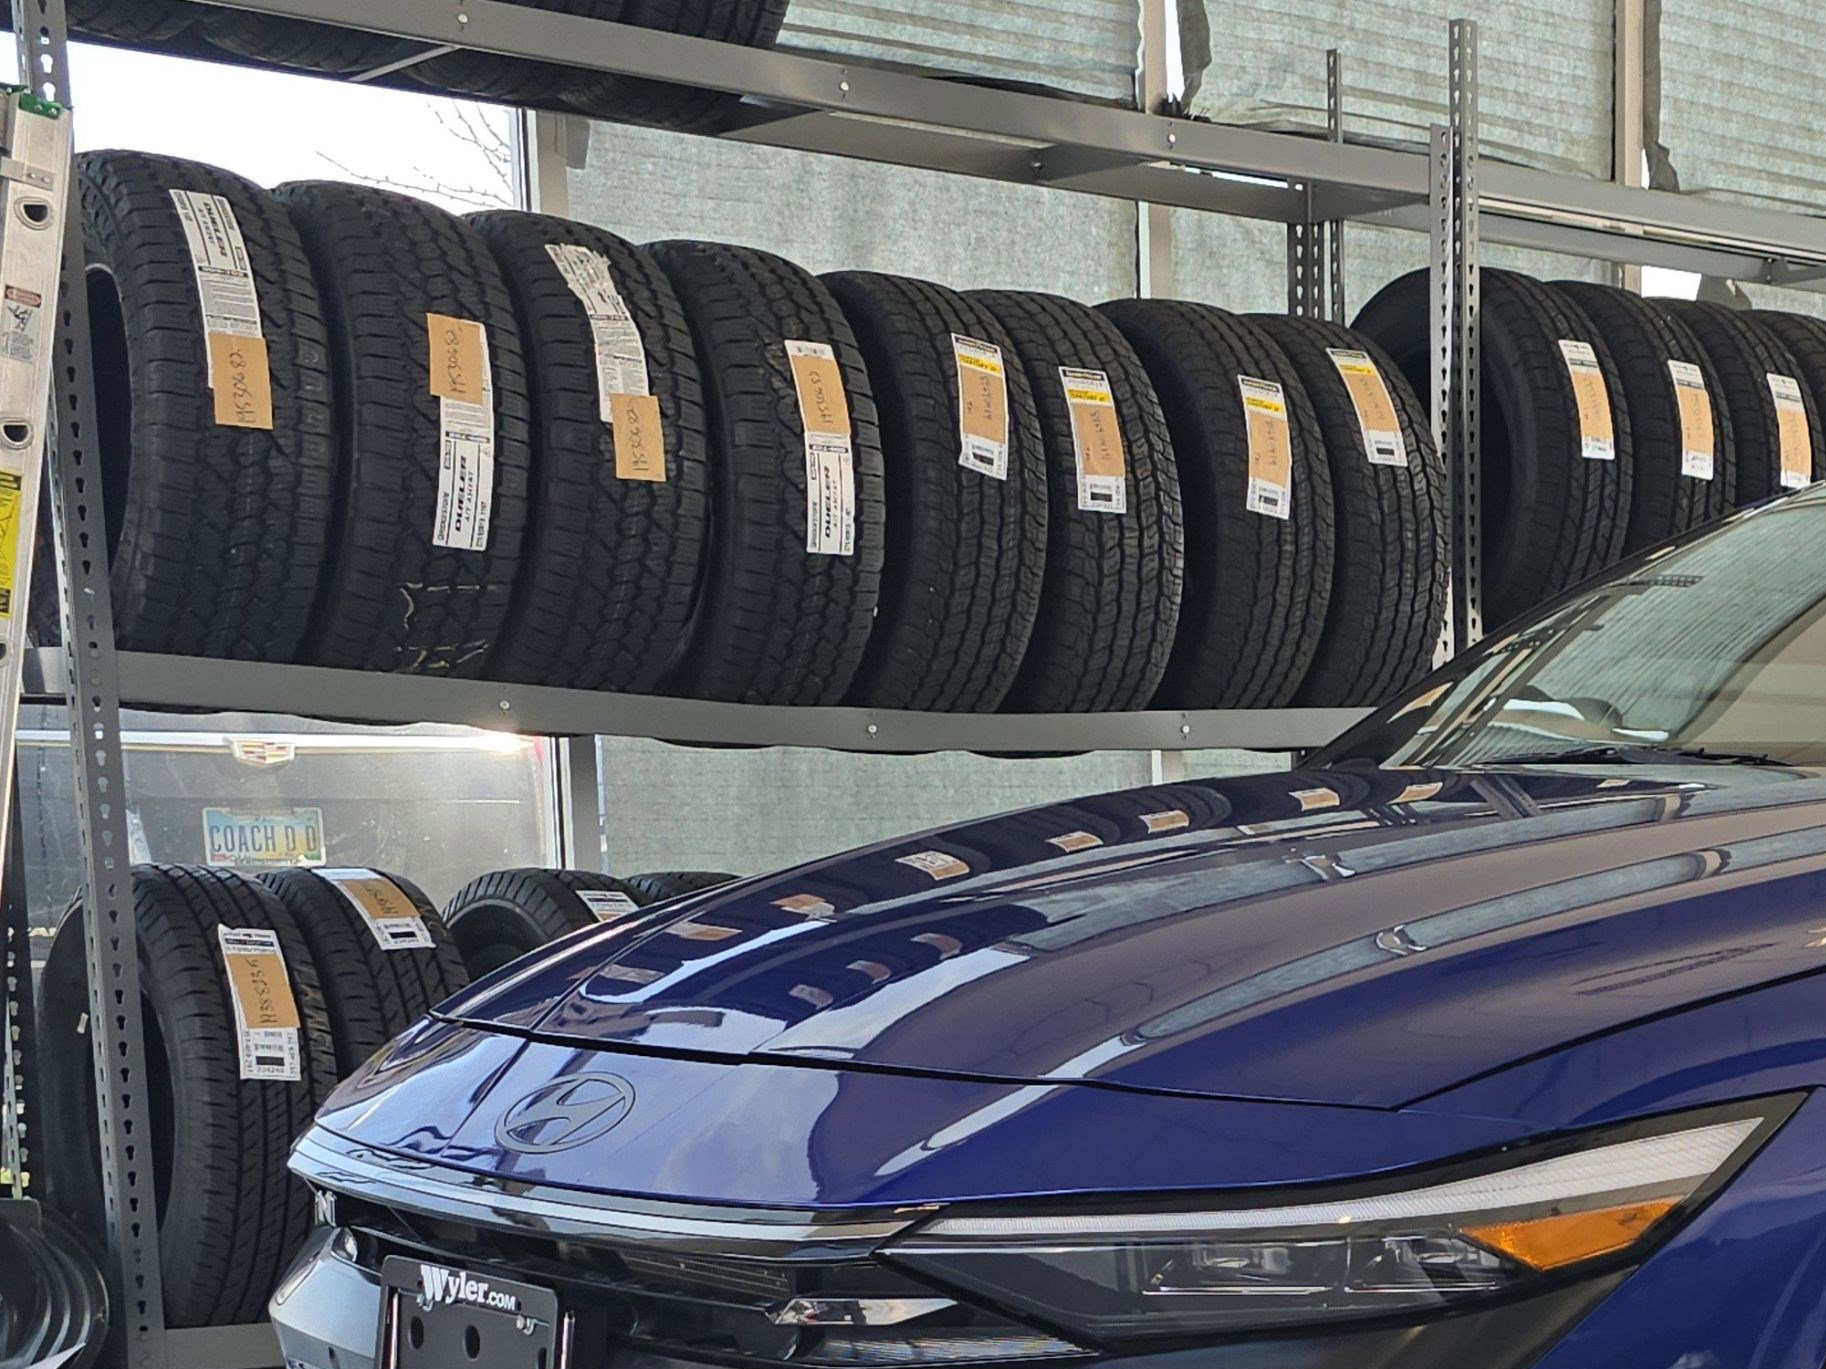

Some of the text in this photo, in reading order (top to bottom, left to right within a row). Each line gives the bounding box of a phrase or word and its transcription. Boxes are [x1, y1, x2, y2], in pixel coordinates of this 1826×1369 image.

[455, 455, 467, 533] DUELER
[210, 825, 317, 853] COACH D D
